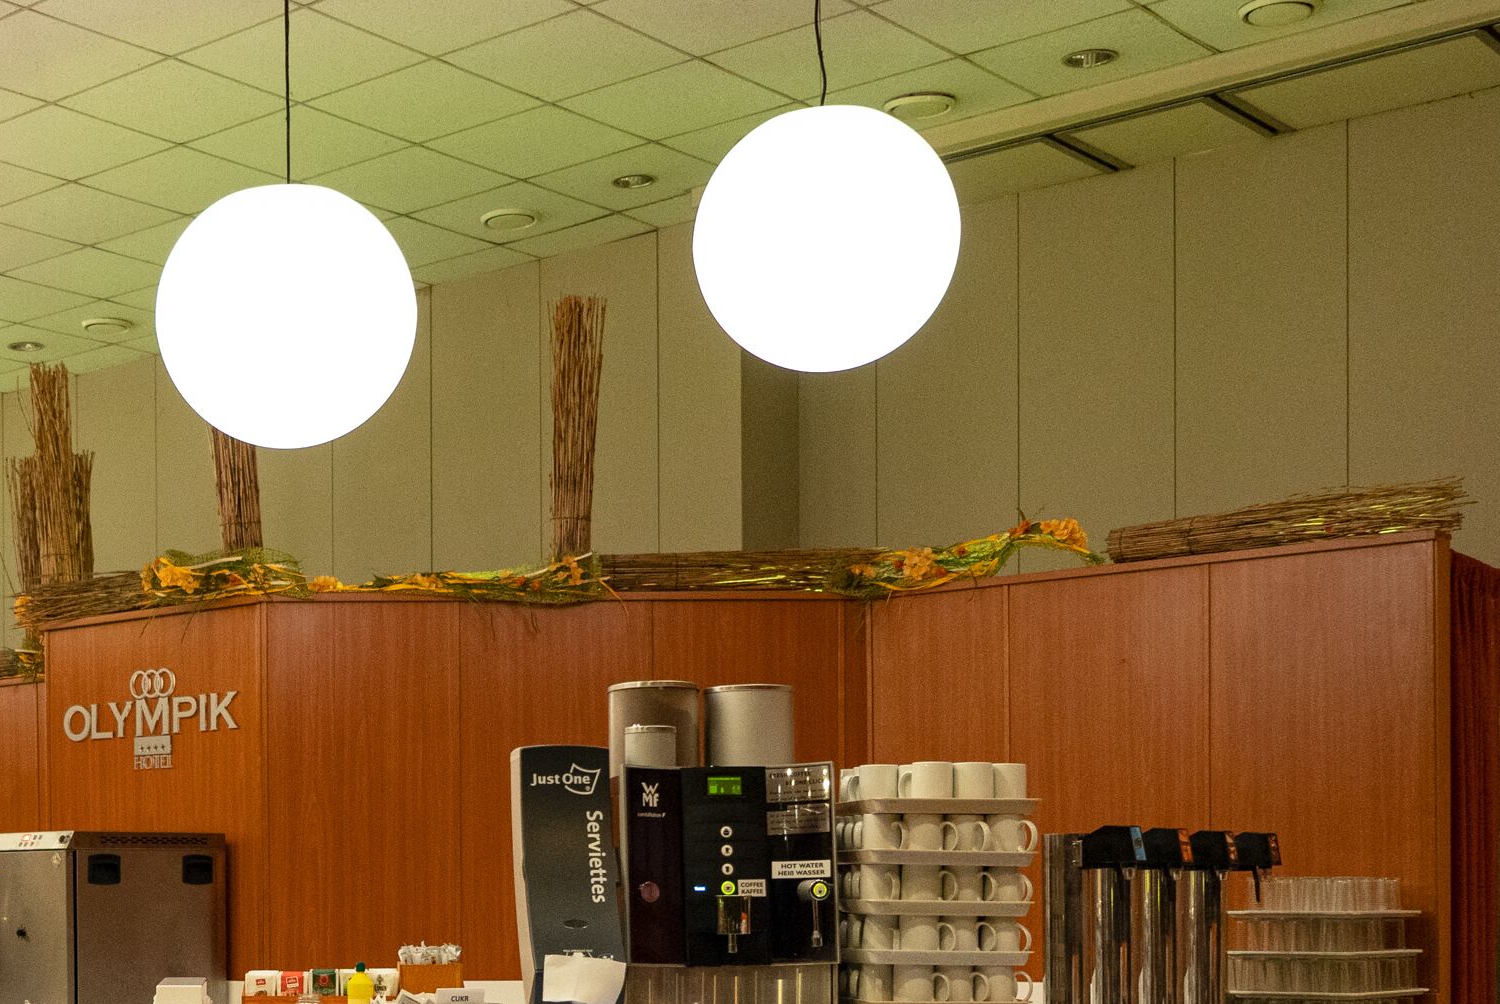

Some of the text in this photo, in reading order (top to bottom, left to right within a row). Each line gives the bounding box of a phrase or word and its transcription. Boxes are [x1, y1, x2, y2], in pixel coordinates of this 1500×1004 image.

[63, 691, 238, 742] OLYMPIK
[133, 754, 173, 770] HOTEL
[530, 773, 591, 786] Just One
[641, 782, 659, 807] WMF
[586, 810, 608, 904] Serviettes
